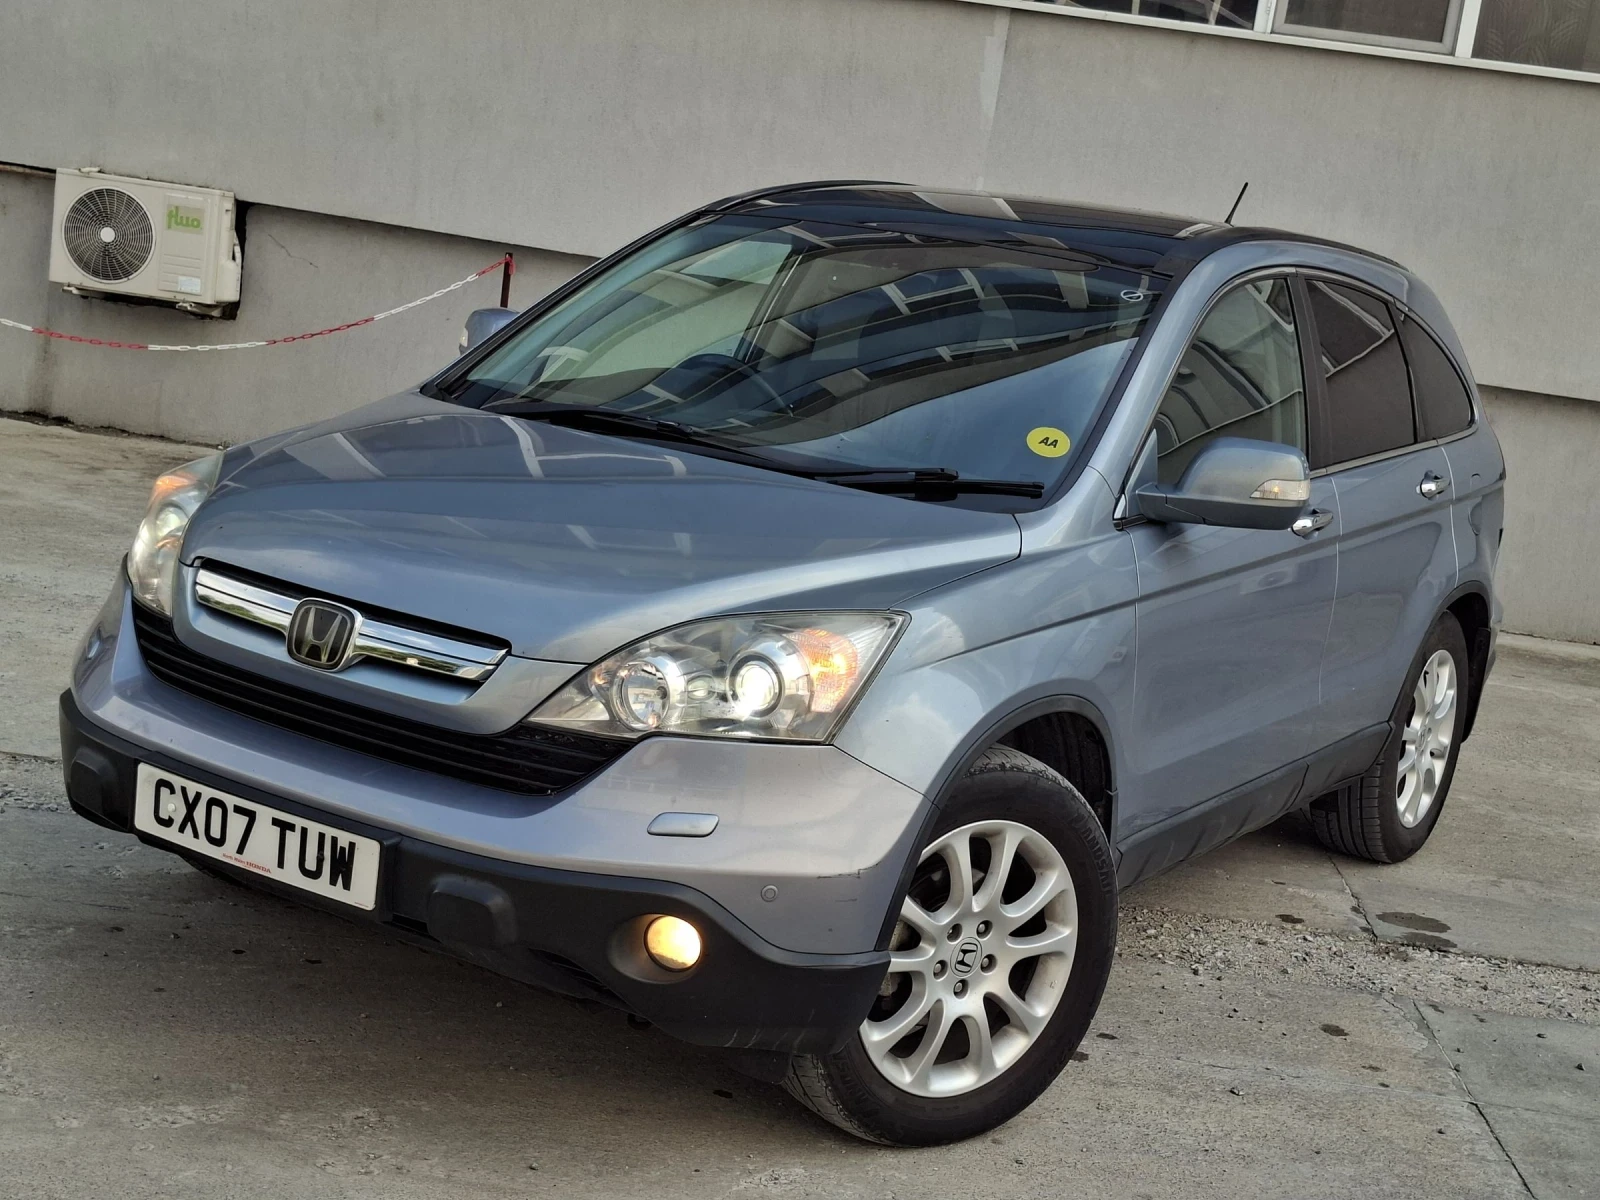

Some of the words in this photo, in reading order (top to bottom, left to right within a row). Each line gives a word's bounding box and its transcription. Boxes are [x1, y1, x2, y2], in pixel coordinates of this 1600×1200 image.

[1038, 436, 1059, 449] AA
[153, 778, 257, 856] CX07
[271, 817, 357, 891] TUW
[246, 861, 272, 874] HONDA
